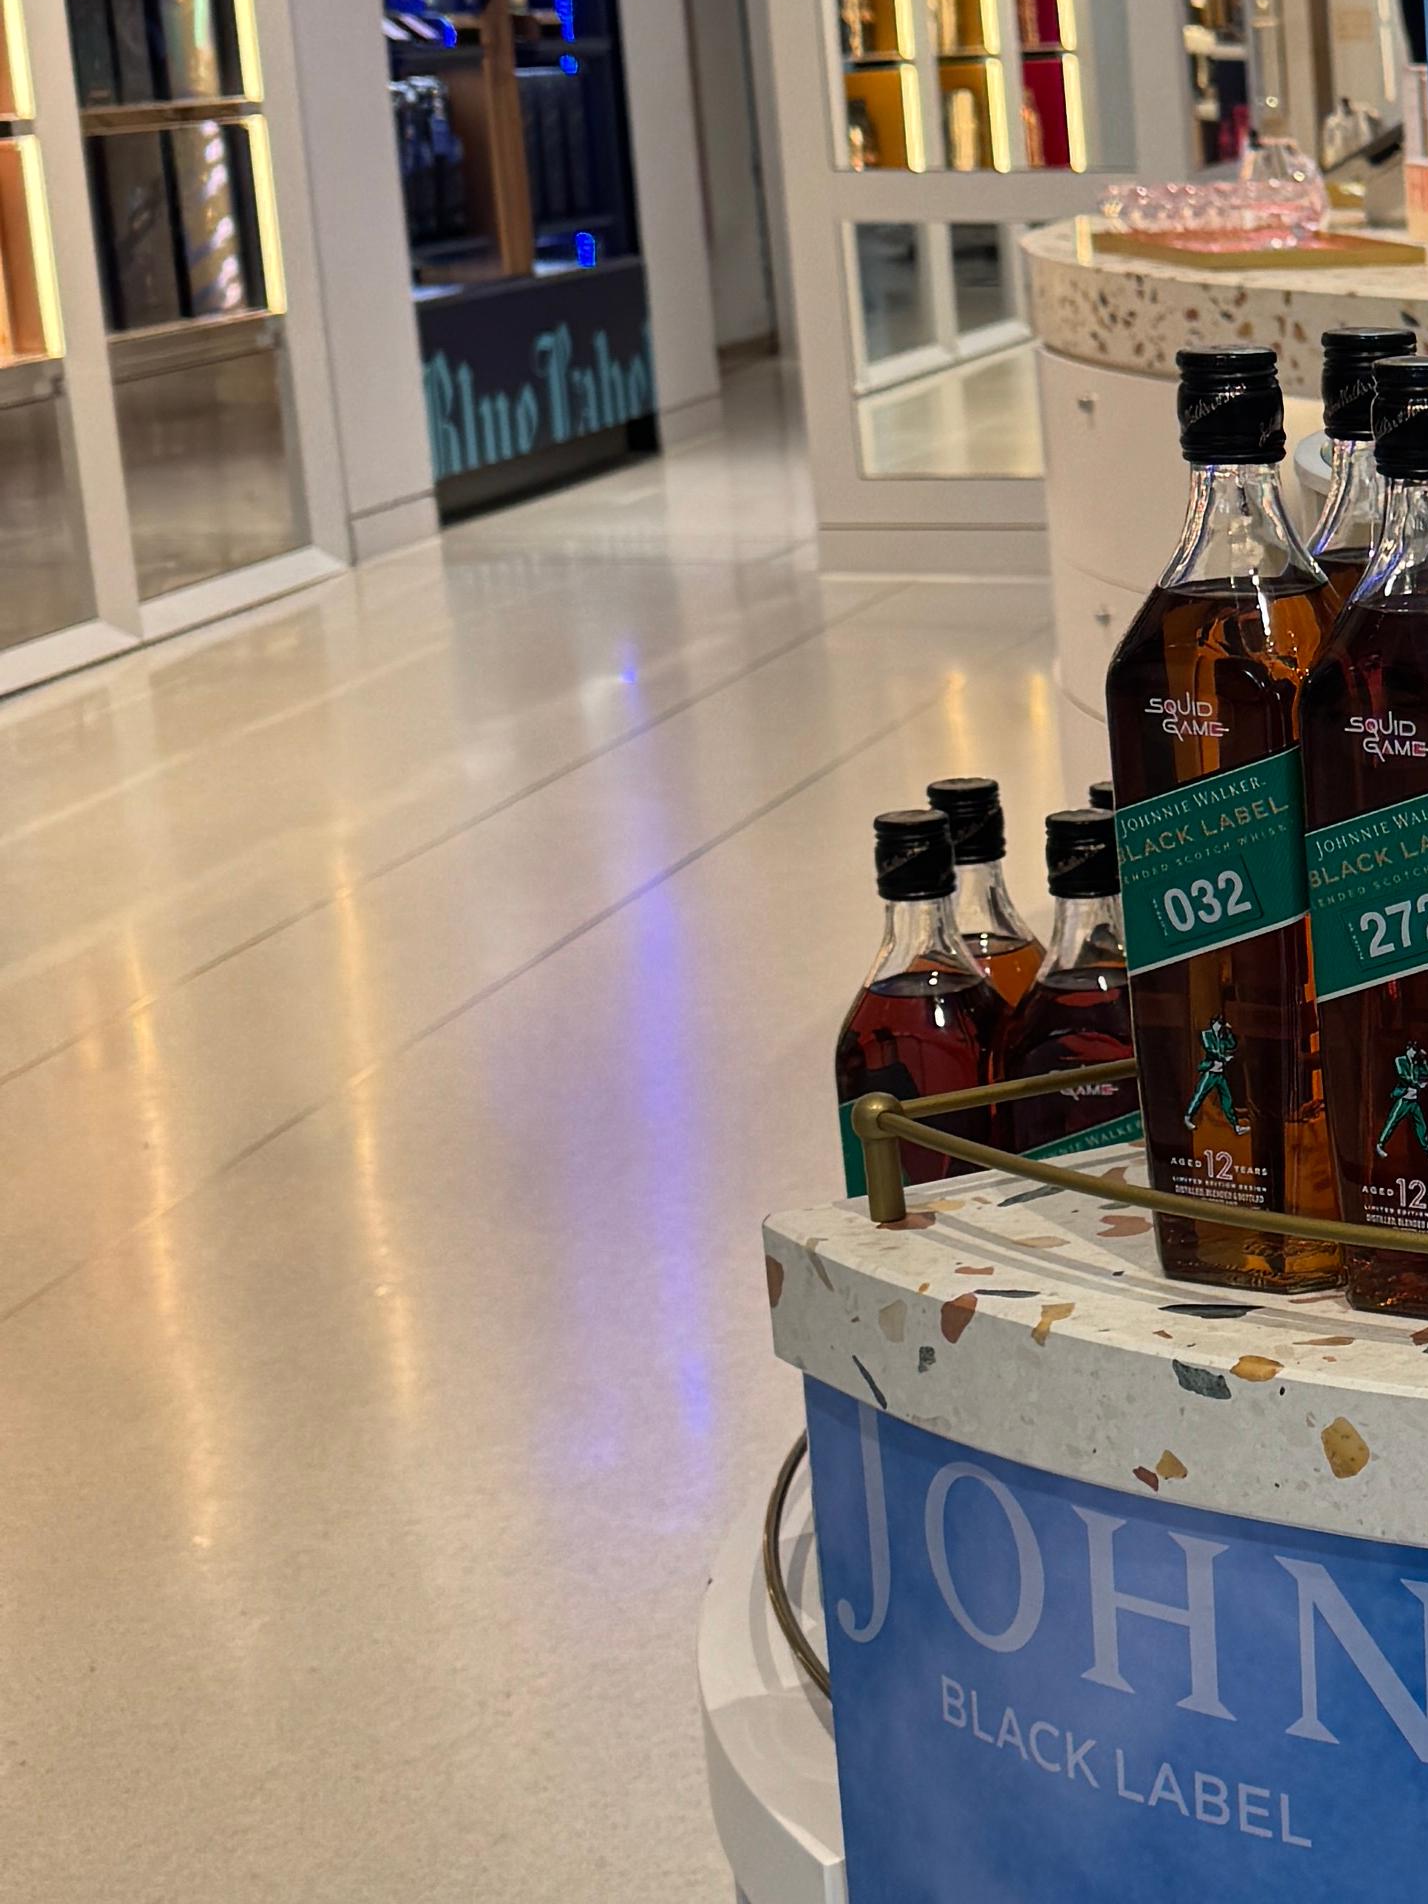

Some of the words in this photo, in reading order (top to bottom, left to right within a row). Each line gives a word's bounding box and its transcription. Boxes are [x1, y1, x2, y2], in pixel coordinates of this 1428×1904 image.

[1145, 692, 1213, 721] SQUID
[1344, 711, 1416, 742] SQUID
[1162, 718, 1230, 742] GAME
[1120, 800, 1191, 839] JOHNNIE
[1193, 776, 1264, 807] WALKER
[1201, 796, 1289, 836] LABEL
[1316, 822, 1390, 862] JOHNNIE
[1308, 847, 1393, 889] BLACK
[1164, 870, 1252, 933] 032
[1170, 1156, 1202, 1168] AGED
[1203, 1149, 1233, 1181] 12
[1234, 1165, 1268, 1176] YEARS
[1362, 1185, 1394, 1196] AGED
[1395, 1177, 1427, 1209] 12
[940, 1673, 1100, 1789] BLACK
[1114, 1747, 1314, 1848] LABEL
